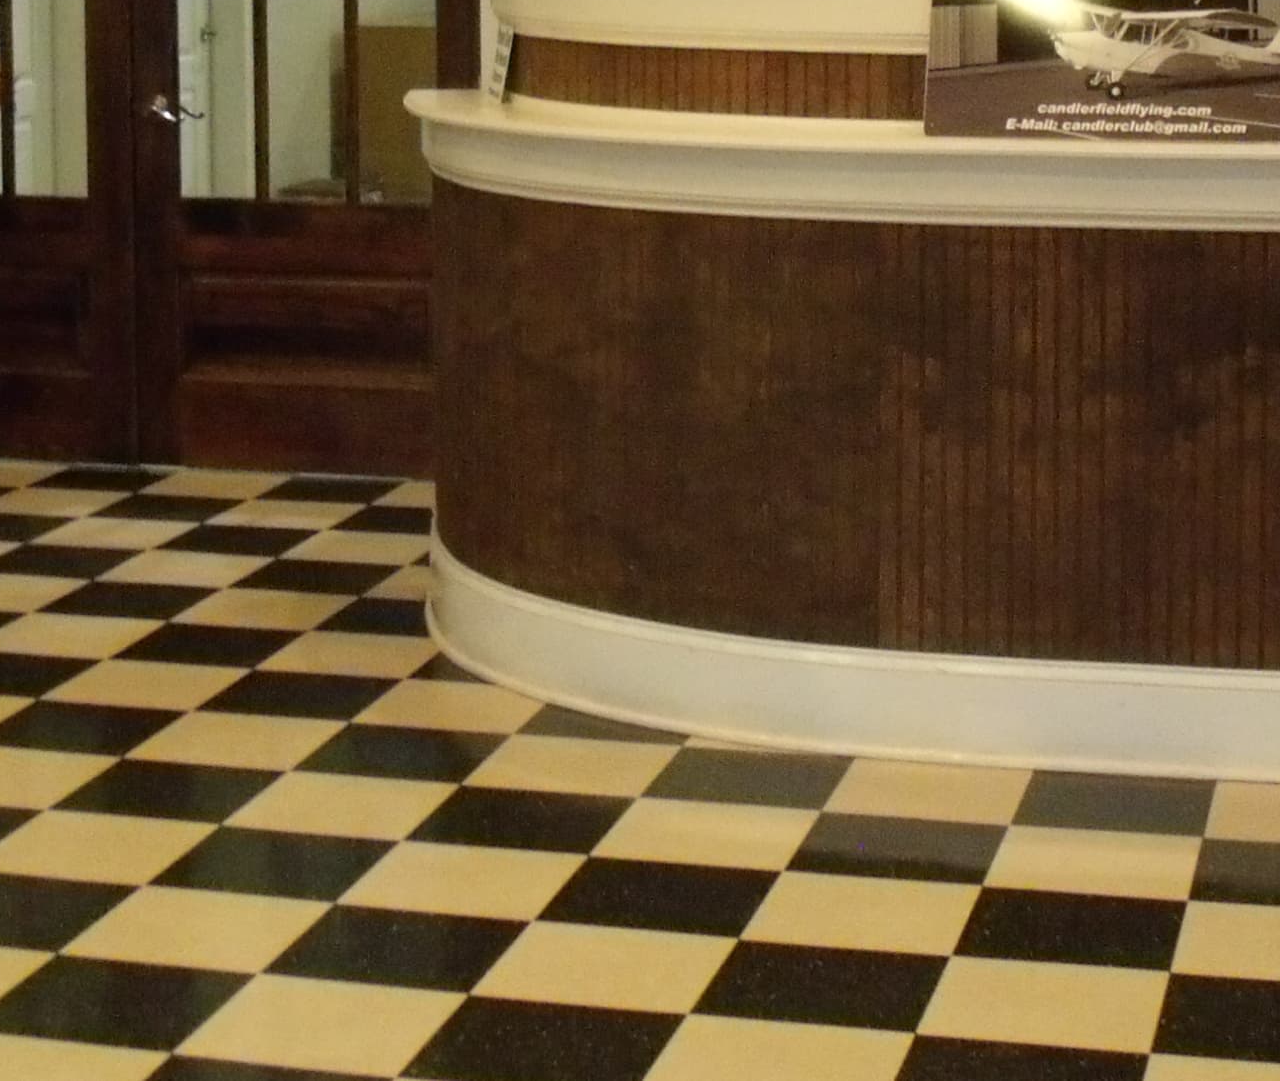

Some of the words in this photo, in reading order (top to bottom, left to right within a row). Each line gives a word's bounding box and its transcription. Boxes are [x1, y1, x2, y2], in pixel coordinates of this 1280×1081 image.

[1037, 102, 1213, 118] candlerfieldflying.com
[1005, 117, 1059, 131] E-Mail:
[1062, 119, 1248, 136] candlerclub@gmail.com
